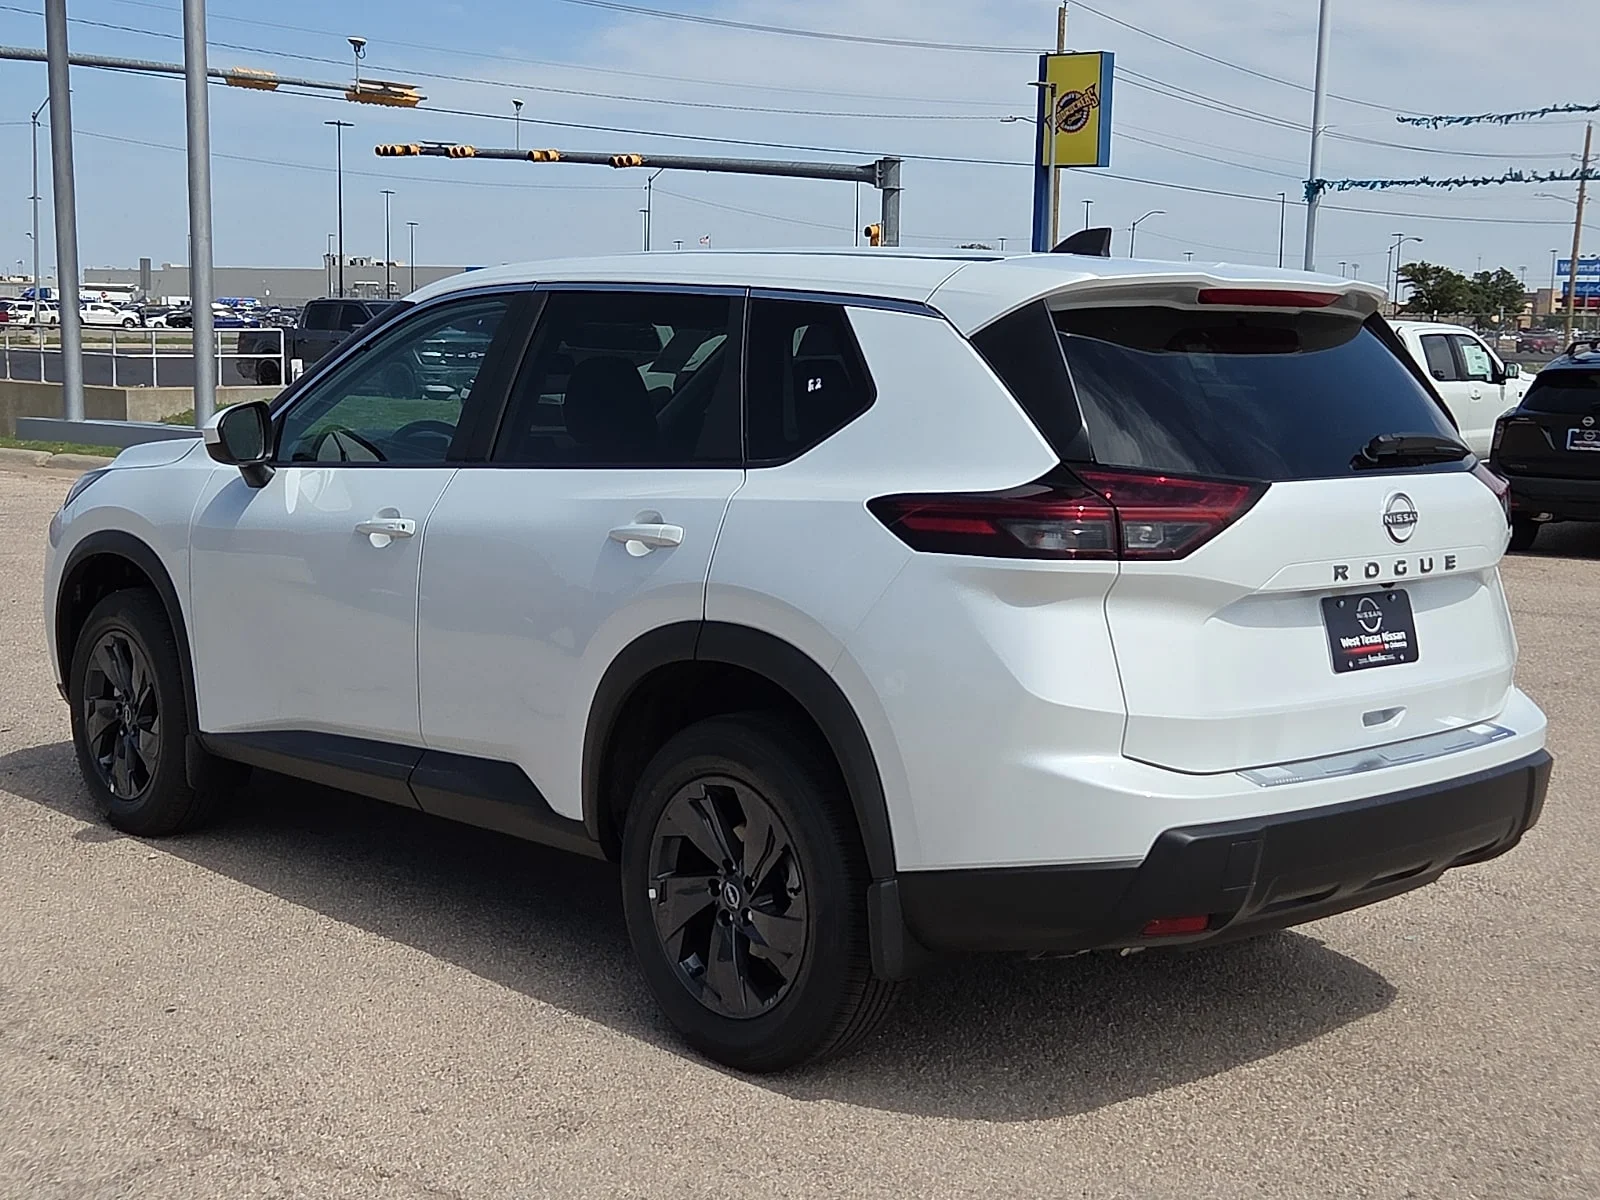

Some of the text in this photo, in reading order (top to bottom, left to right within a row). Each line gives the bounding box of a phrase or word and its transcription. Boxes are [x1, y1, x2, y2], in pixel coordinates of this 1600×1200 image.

[1384, 512, 1418, 524] NISSAN
[1333, 555, 1457, 582] ROGUE
[1340, 631, 1406, 648] West Texas Nissan
